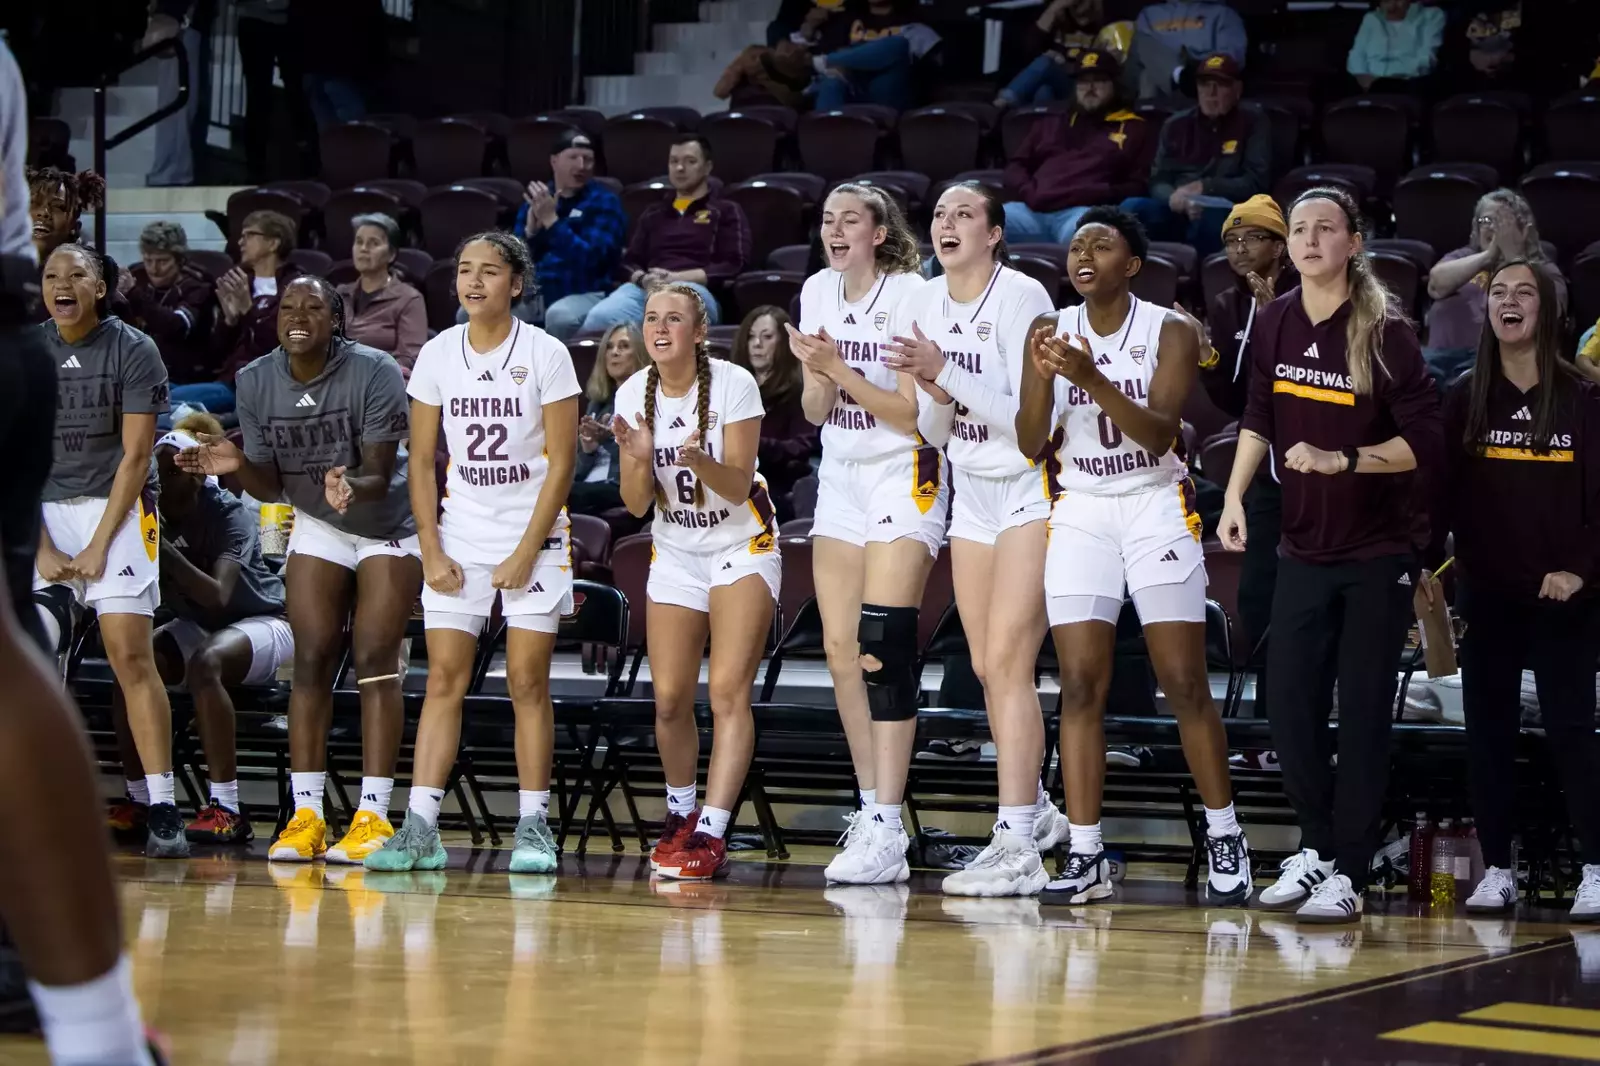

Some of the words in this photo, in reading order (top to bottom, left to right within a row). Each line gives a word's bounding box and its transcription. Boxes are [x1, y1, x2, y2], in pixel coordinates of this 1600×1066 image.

[1275, 363, 1353, 390] CHIPPEWAS
[1068, 378, 1147, 406] CEAL
[450, 397, 523, 418] CENTRAL
[465, 423, 509, 462] 22
[1097, 411, 1122, 450] 0
[1482, 430, 1572, 448] HIPPEAS
[675, 470, 694, 505] 6
